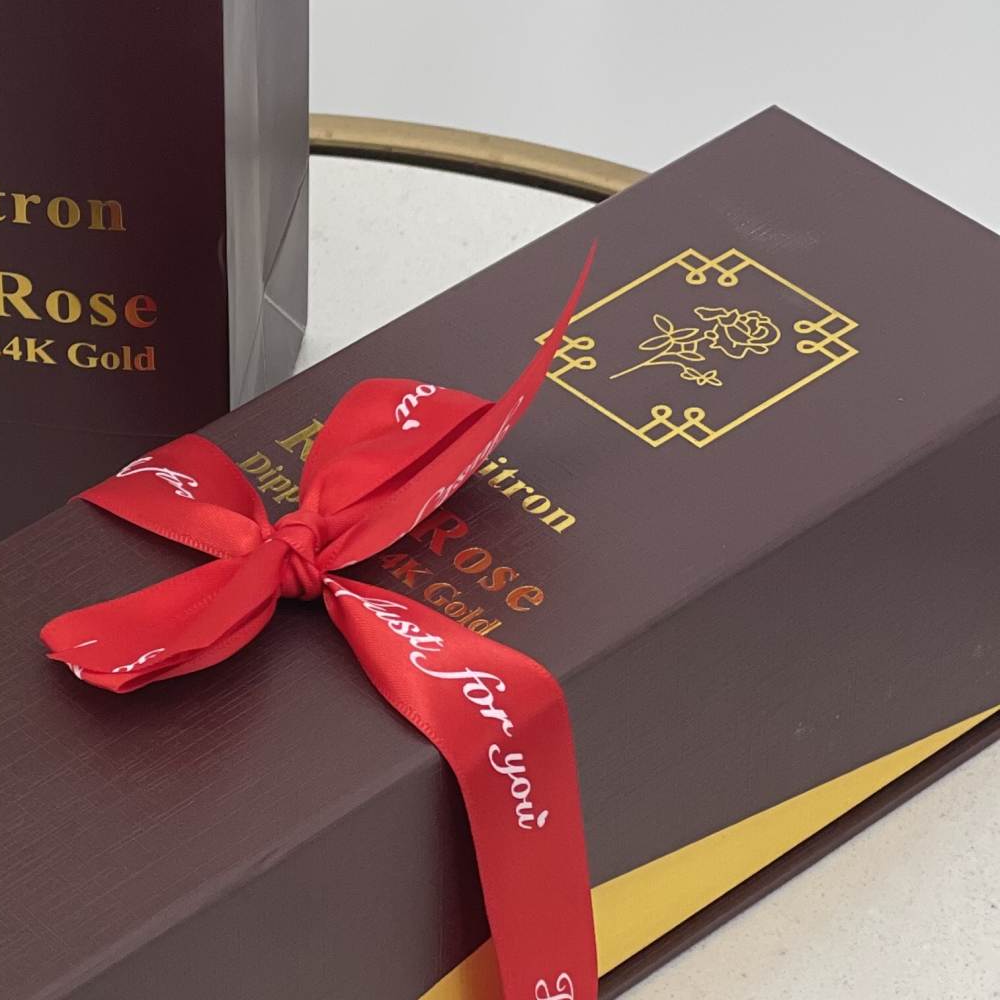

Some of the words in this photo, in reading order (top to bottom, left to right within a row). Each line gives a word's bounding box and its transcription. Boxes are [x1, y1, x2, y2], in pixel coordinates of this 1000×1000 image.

[67, 342, 157, 371] Gold
[477, 456, 577, 534] itron
[236, 451, 300, 504] Dipp
[423, 582, 503, 636] Gold
[409, 507, 545, 612] Rose
[409, 651, 514, 738] for
